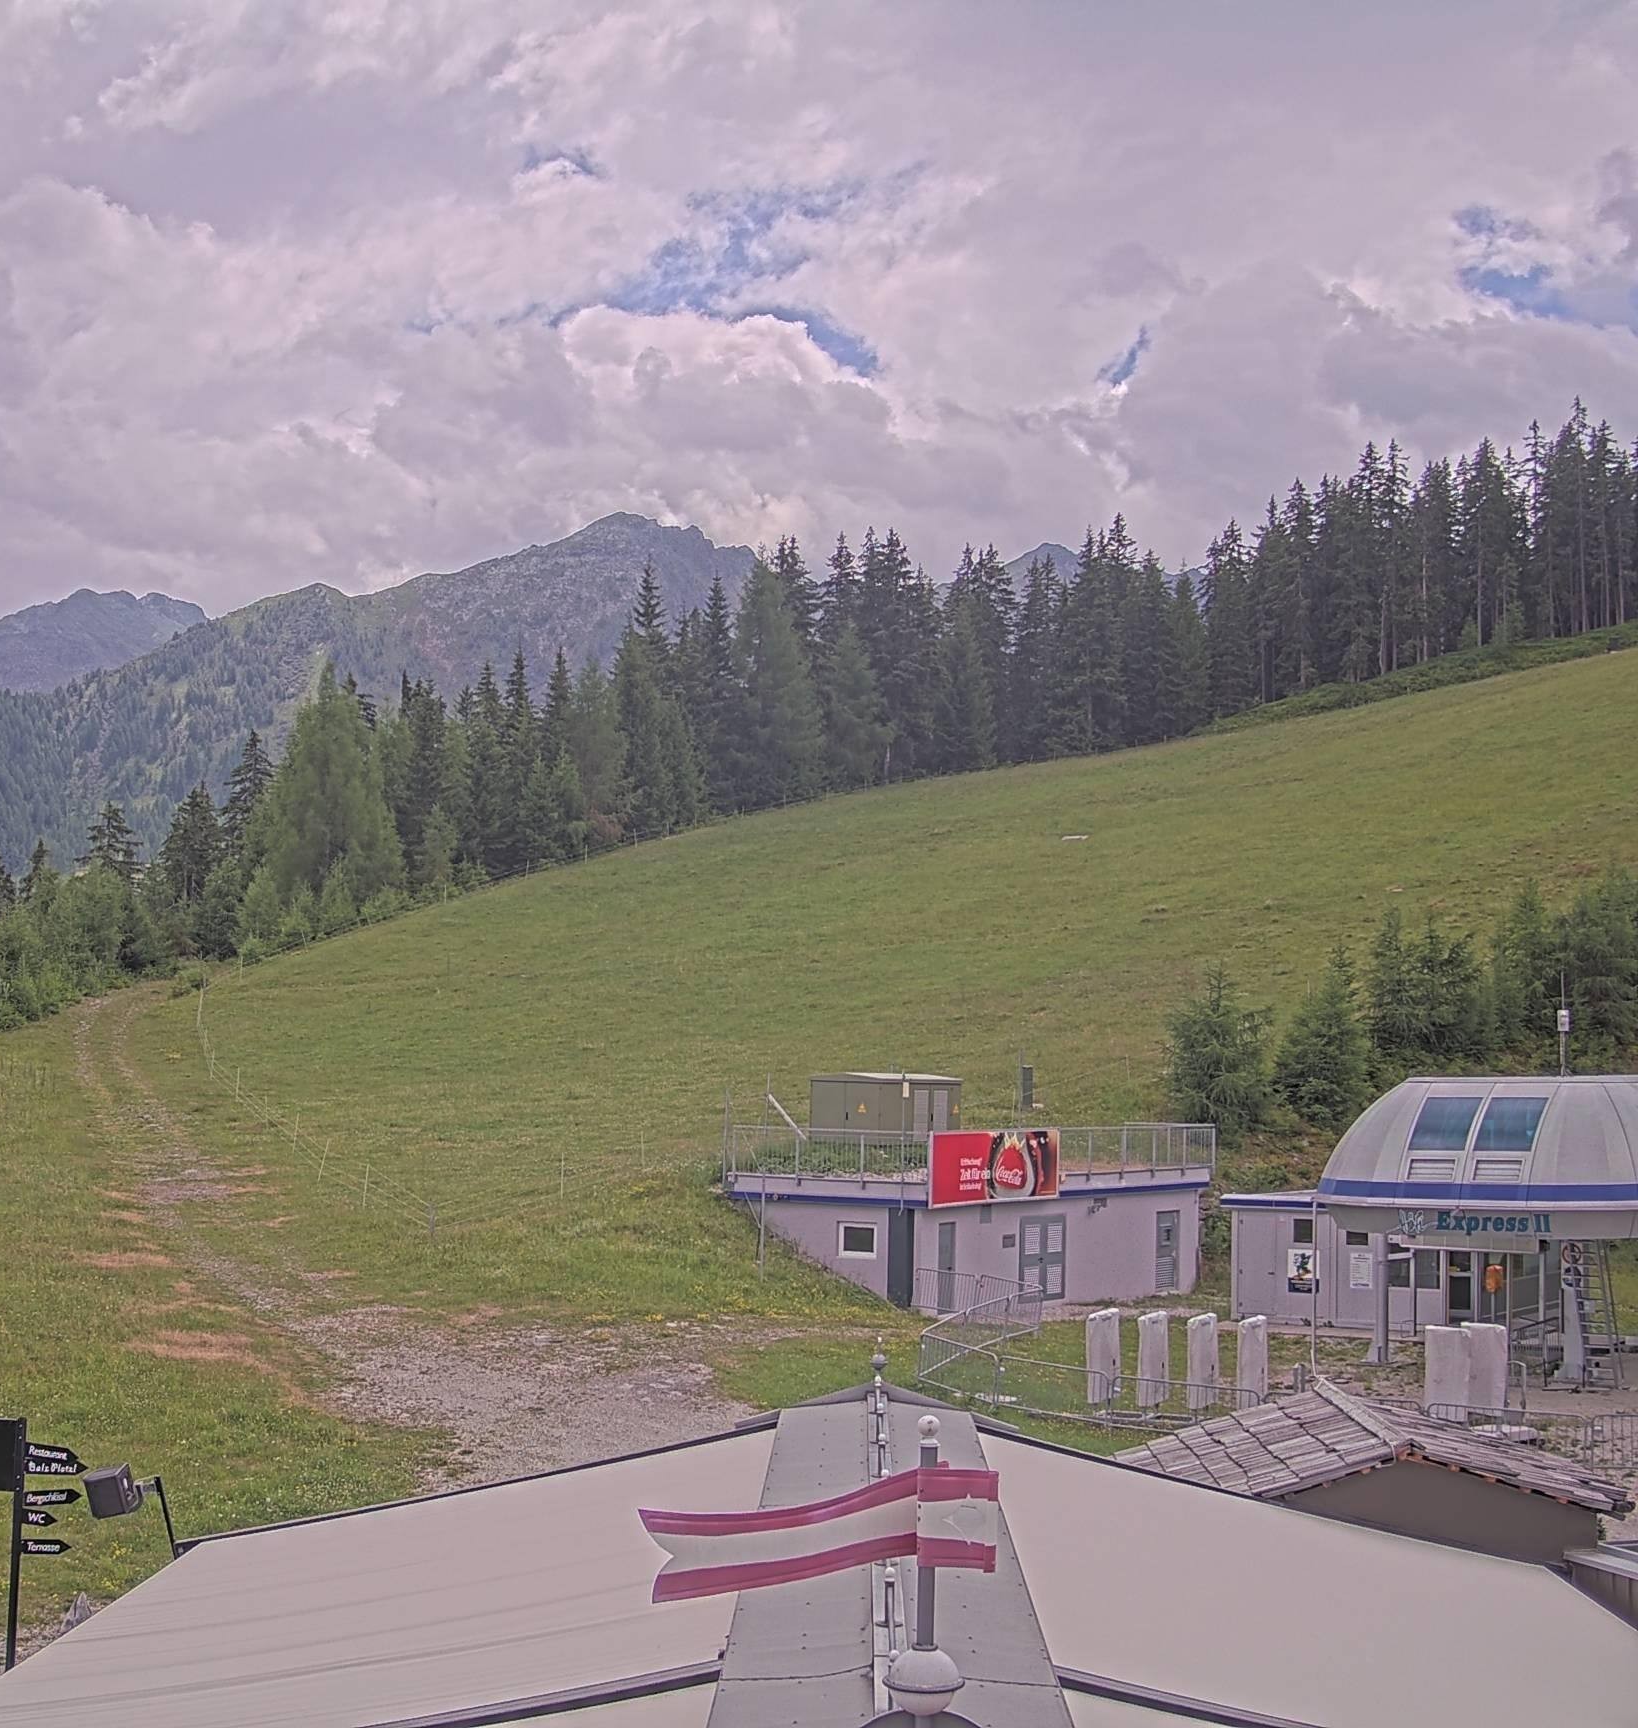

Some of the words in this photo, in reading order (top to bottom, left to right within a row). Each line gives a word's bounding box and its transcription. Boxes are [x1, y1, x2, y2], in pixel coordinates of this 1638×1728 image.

[1436, 1211, 1529, 1235] Express
[28, 1445, 68, 1460] Restaurant
[28, 1512, 46, 1523] WC
[27, 1541, 60, 1552] Terrasse
